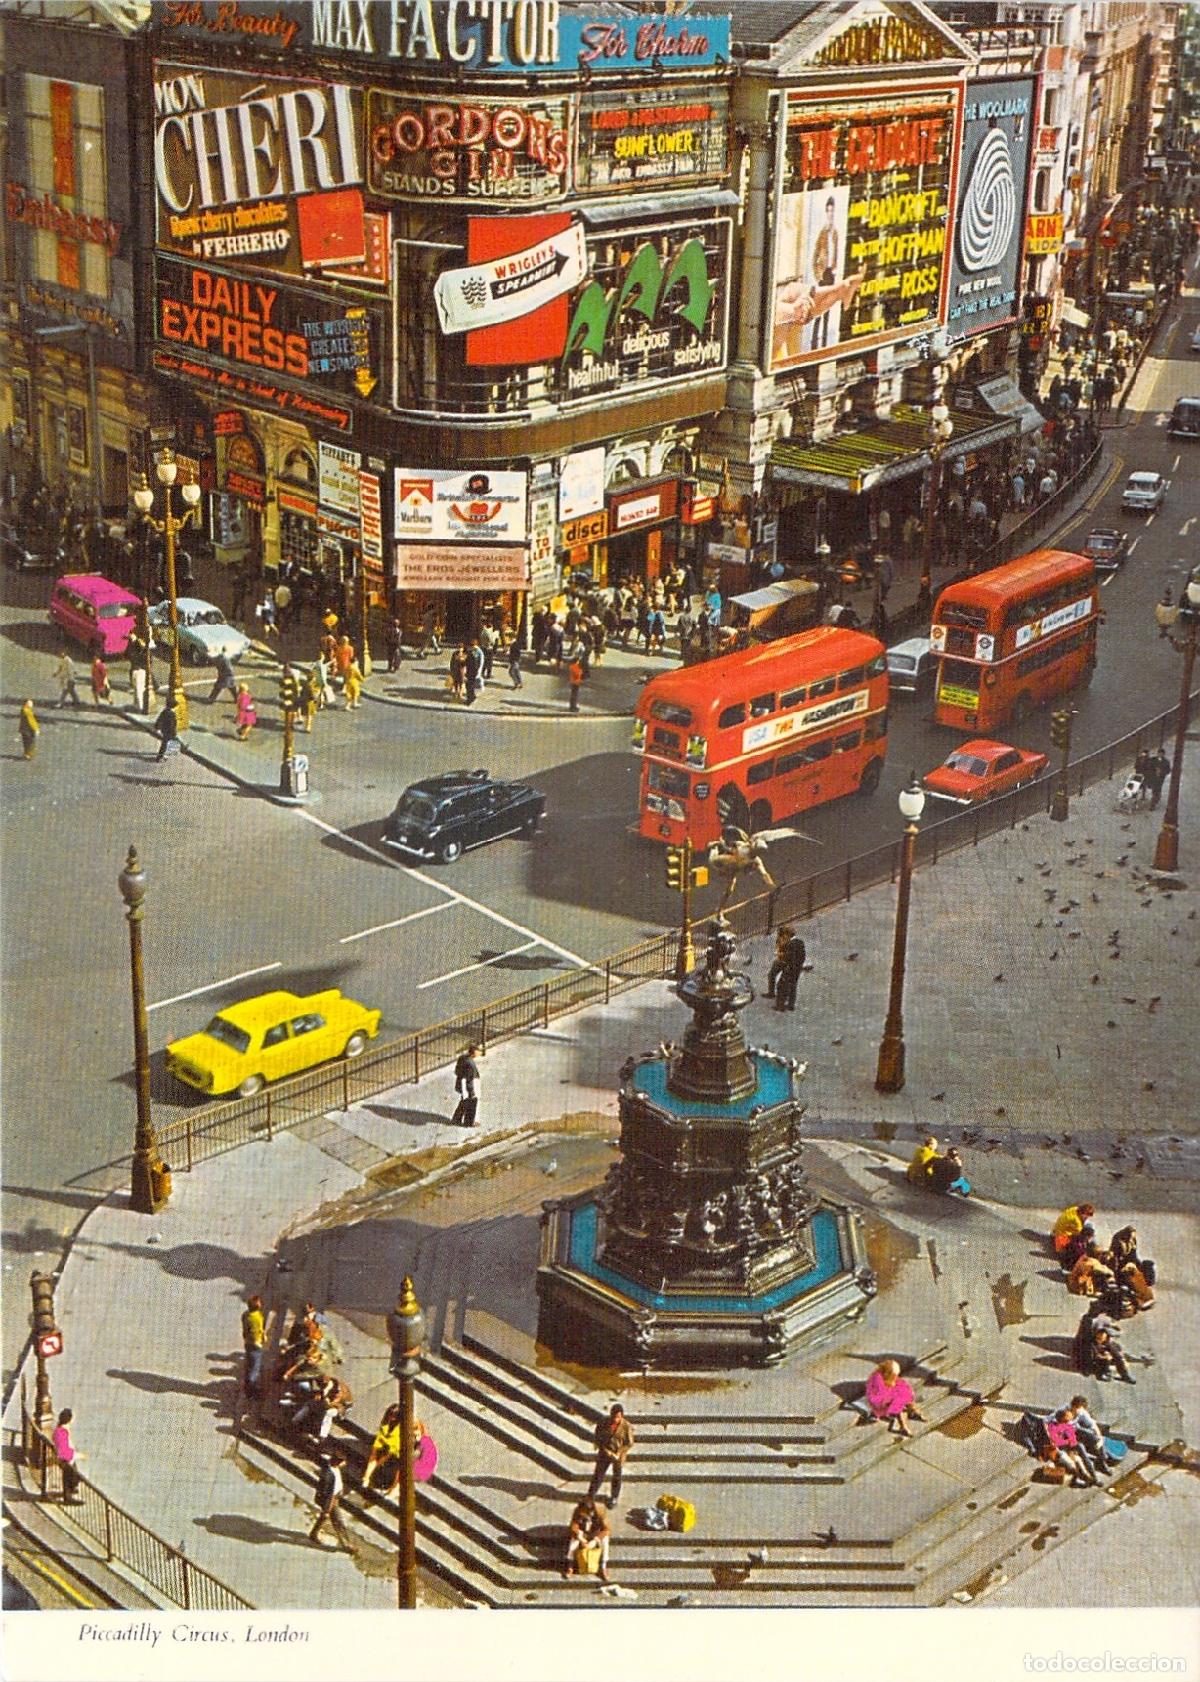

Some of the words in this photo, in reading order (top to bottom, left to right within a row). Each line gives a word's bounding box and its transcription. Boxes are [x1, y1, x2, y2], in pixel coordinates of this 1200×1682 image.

[311, 0, 374, 53] MAX
[388, 0, 560, 64] FACTOR
[578, 22, 628, 65] For
[635, 24, 710, 59] Charm
[154, 73, 206, 114] MON
[978, 97, 1030, 120] WOOLMARK
[154, 84, 366, 213] CHÉRI
[614, 129, 693, 159] SUNFLOWER
[430, 148, 515, 181] GIN
[382, 171, 456, 195] STANDS
[869, 189, 940, 229] BANCROFT
[202, 230, 290, 258] FERRERO
[878, 226, 946, 266] HOFFMAN
[192, 270, 277, 324] DAILY
[900, 265, 939, 300] ROSS
[161, 298, 309, 379] EXPRESS
[622, 329, 670, 355] delicious
[673, 340, 722, 367] satisfying
[567, 359, 621, 390] healthful
[533, 546, 551, 561] LET
[535, 537, 550, 549] TO
[403, 564, 423, 573] THE
[426, 564, 455, 574] EROS
[457, 564, 521, 575] JEWELLERS
